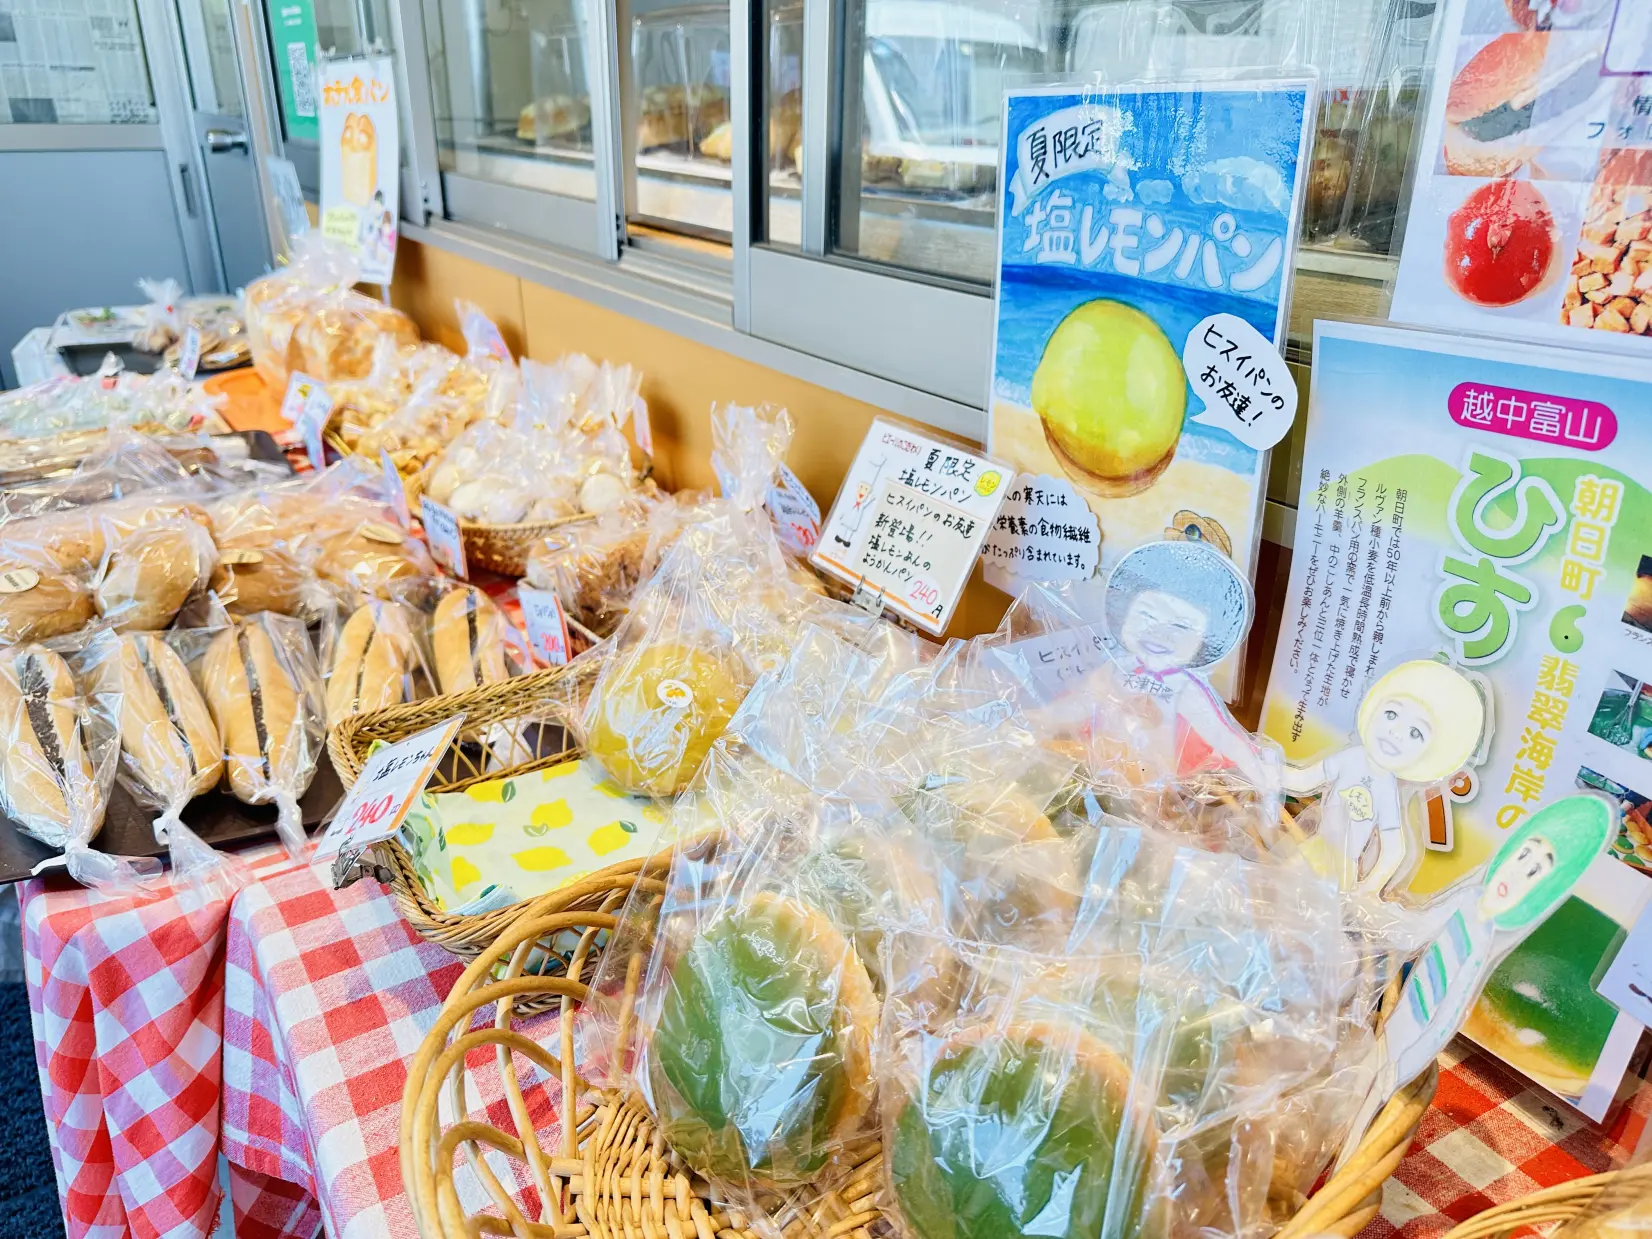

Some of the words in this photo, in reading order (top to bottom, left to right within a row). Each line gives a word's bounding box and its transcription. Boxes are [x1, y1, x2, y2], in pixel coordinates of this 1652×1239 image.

[1027, 118, 1104, 184] 夏限定
[1023, 189, 1283, 292] 塩レモンパン
[1203, 323, 1285, 411] ヒスイパンの
[1461, 388, 1603, 444] 越中富山
[898, 468, 972, 504] 塩レモンパン
[924, 448, 976, 482] 夏限定
[886, 493, 976, 539] ヒスイパンのお友達
[993, 515, 1091, 544] 栄養素の食物繊維
[868, 535, 931, 571] 塩レモンあんの
[1560, 478, 1621, 601] 朝日町
[862, 552, 913, 582] ようかんパン
